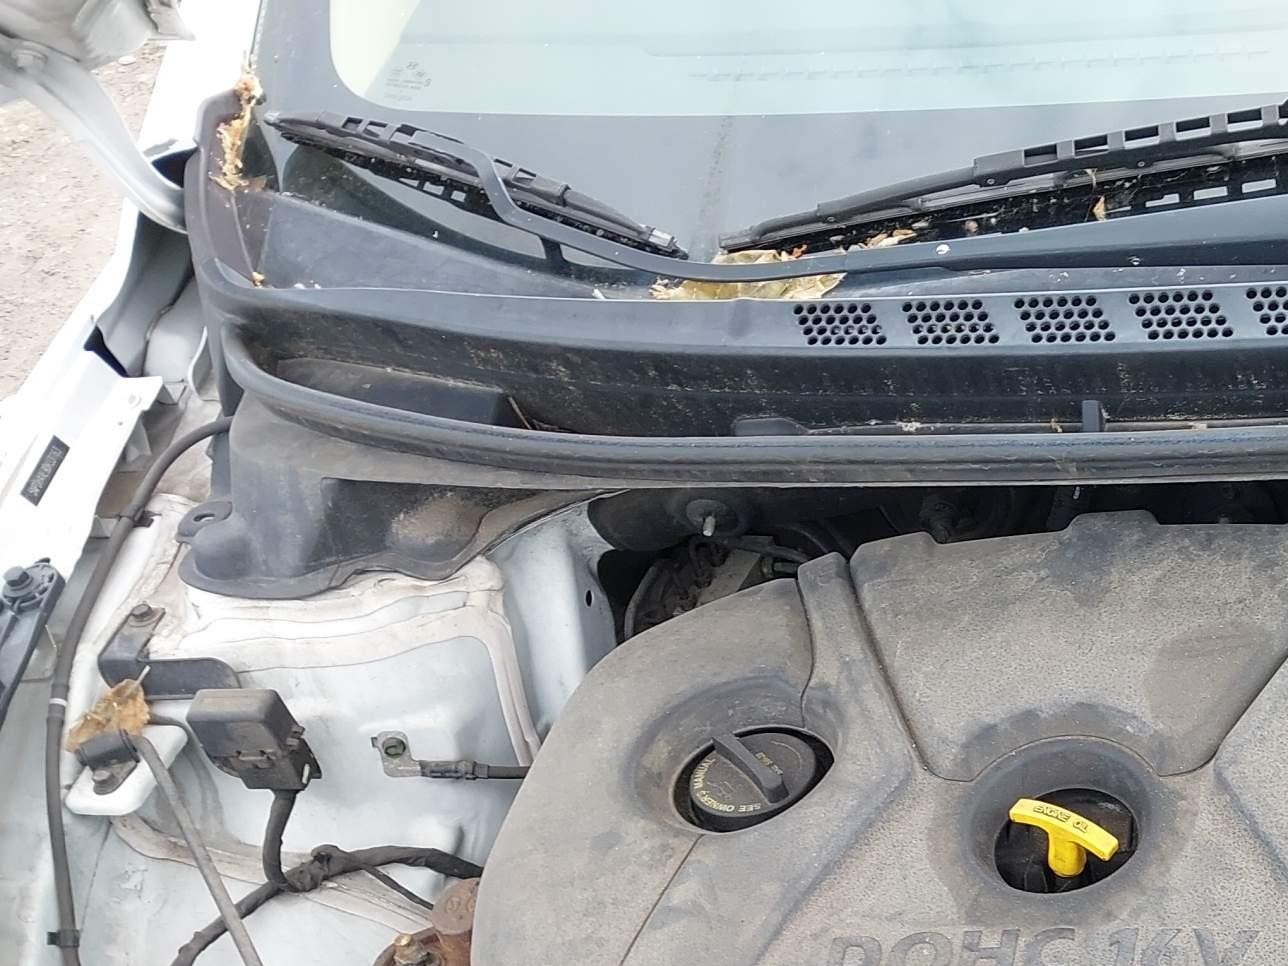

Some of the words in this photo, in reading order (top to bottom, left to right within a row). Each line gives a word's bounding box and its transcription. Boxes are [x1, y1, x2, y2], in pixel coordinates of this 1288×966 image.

[693, 758, 716, 789] MANUAL
[737, 802, 761, 812] SEE
[1033, 805, 1071, 824] ENGINE
[1072, 819, 1089, 834] OIL
